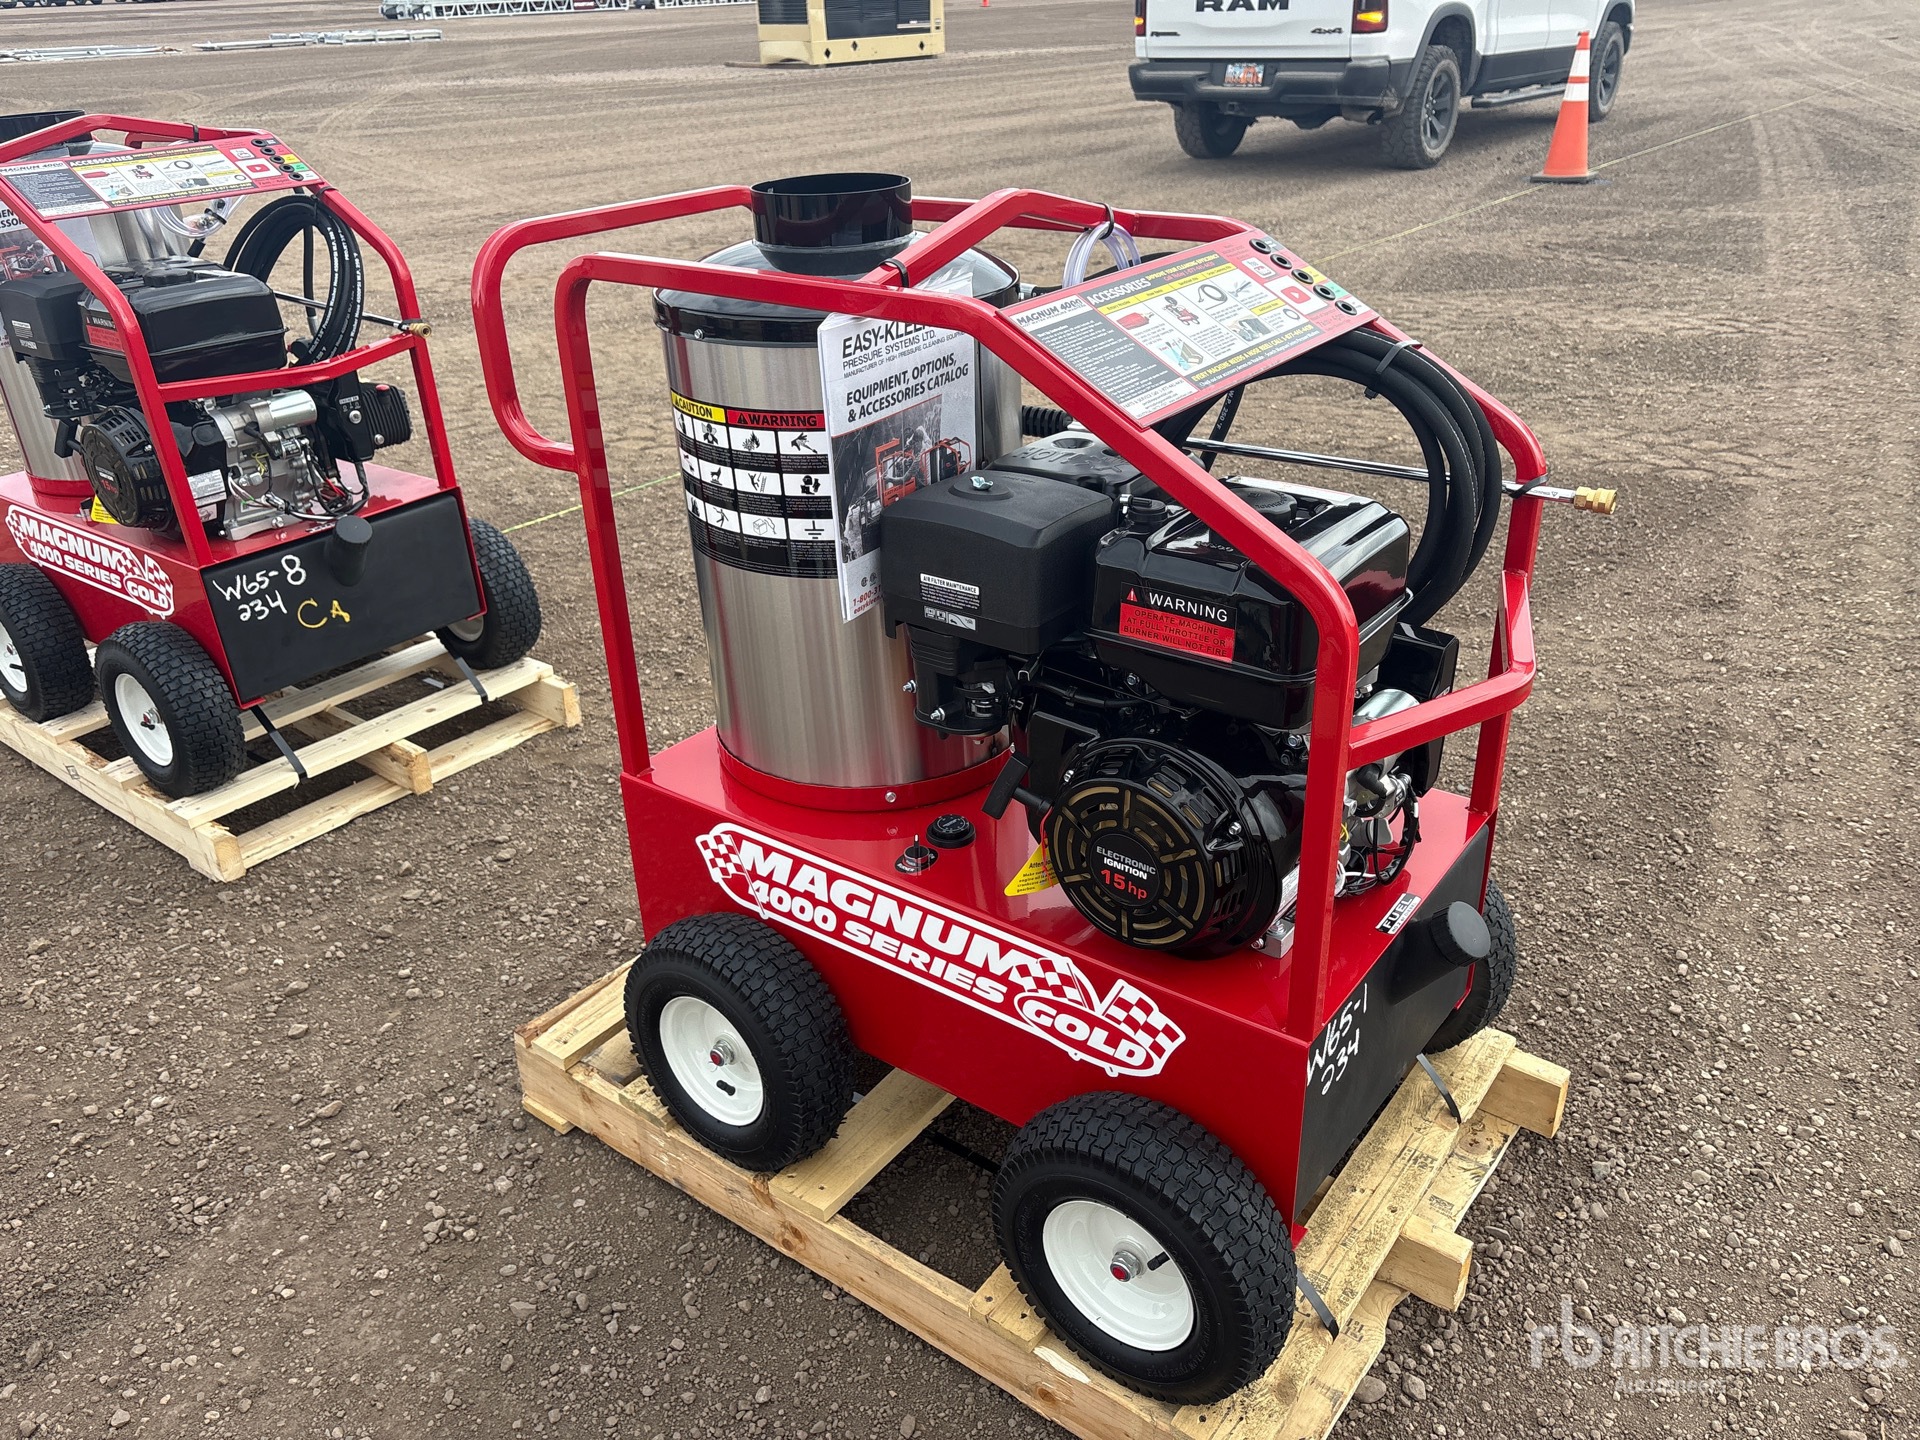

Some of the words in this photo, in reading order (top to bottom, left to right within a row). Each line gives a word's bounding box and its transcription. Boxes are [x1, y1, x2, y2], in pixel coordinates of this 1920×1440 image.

[69, 155, 133, 167] ACCESSORIES
[1087, 278, 1152, 306] ACCESSORIES
[1016, 305, 1060, 326] MAGNUM
[1060, 298, 1084, 310] 4000
[843, 348, 882, 371] PRESSURE
[885, 335, 920, 354] SYSTEMS
[922, 330, 936, 342] LTD.
[844, 362, 878, 378] MANUFACTURER
[886, 354, 898, 362] HIGH
[898, 346, 922, 359] PRESSURE
[922, 337, 946, 350] CLEANING
[1191, 370, 1210, 382] EVERY
[1210, 360, 1231, 376] MACHINE
[1231, 354, 1244, 366] NEEDS
[1248, 346, 1260, 358] HOSE
[1272, 336, 1282, 348] CALL
[846, 370, 910, 406] EQUIPMENT,
[912, 352, 957, 380] OPTIONS,
[848, 408, 856, 422] &
[858, 381, 926, 419] ACCESSORIES
[927, 363, 968, 391] CATALOG
[678, 398, 712, 418] CAUTION
[749, 414, 817, 426] WARNING
[1220, 408, 1228, 421] 250
[18, 515, 122, 571] MAGNUM
[30, 540, 63, 566] 4000
[64, 556, 122, 589] SERIES
[212, 554, 307, 601] W65-8
[127, 580, 168, 609] GOLD
[931, 576, 946, 586] FILTER
[946, 580, 976, 594] MAINTENANCE
[238, 590, 287, 622] 234
[1150, 592, 1228, 622] WARNING
[1134, 610, 1176, 624] OPERATE
[1178, 620, 1218, 636] MACHINE
[1140, 620, 1160, 630] FULL
[1164, 625, 1210, 642] THROTTLE
[1213, 640, 1226, 648] OR
[1124, 626, 1159, 640] BURNER
[1162, 634, 1182, 646] WILL
[1186, 642, 1204, 650] NOT
[1207, 646, 1227, 656] FIRE
[1096, 846, 1156, 874] ELECTRONIC
[1104, 856, 1148, 880] IGNITION
[737, 838, 1028, 978] MAGNUM
[1382, 898, 1412, 928] FUEL
[747, 877, 836, 933] 4000
[844, 921, 1006, 1004] SERIES
[1022, 999, 1146, 1066] GOLD
[1306, 982, 1368, 1086] W65-1
[1321, 1028, 1360, 1095] 234
